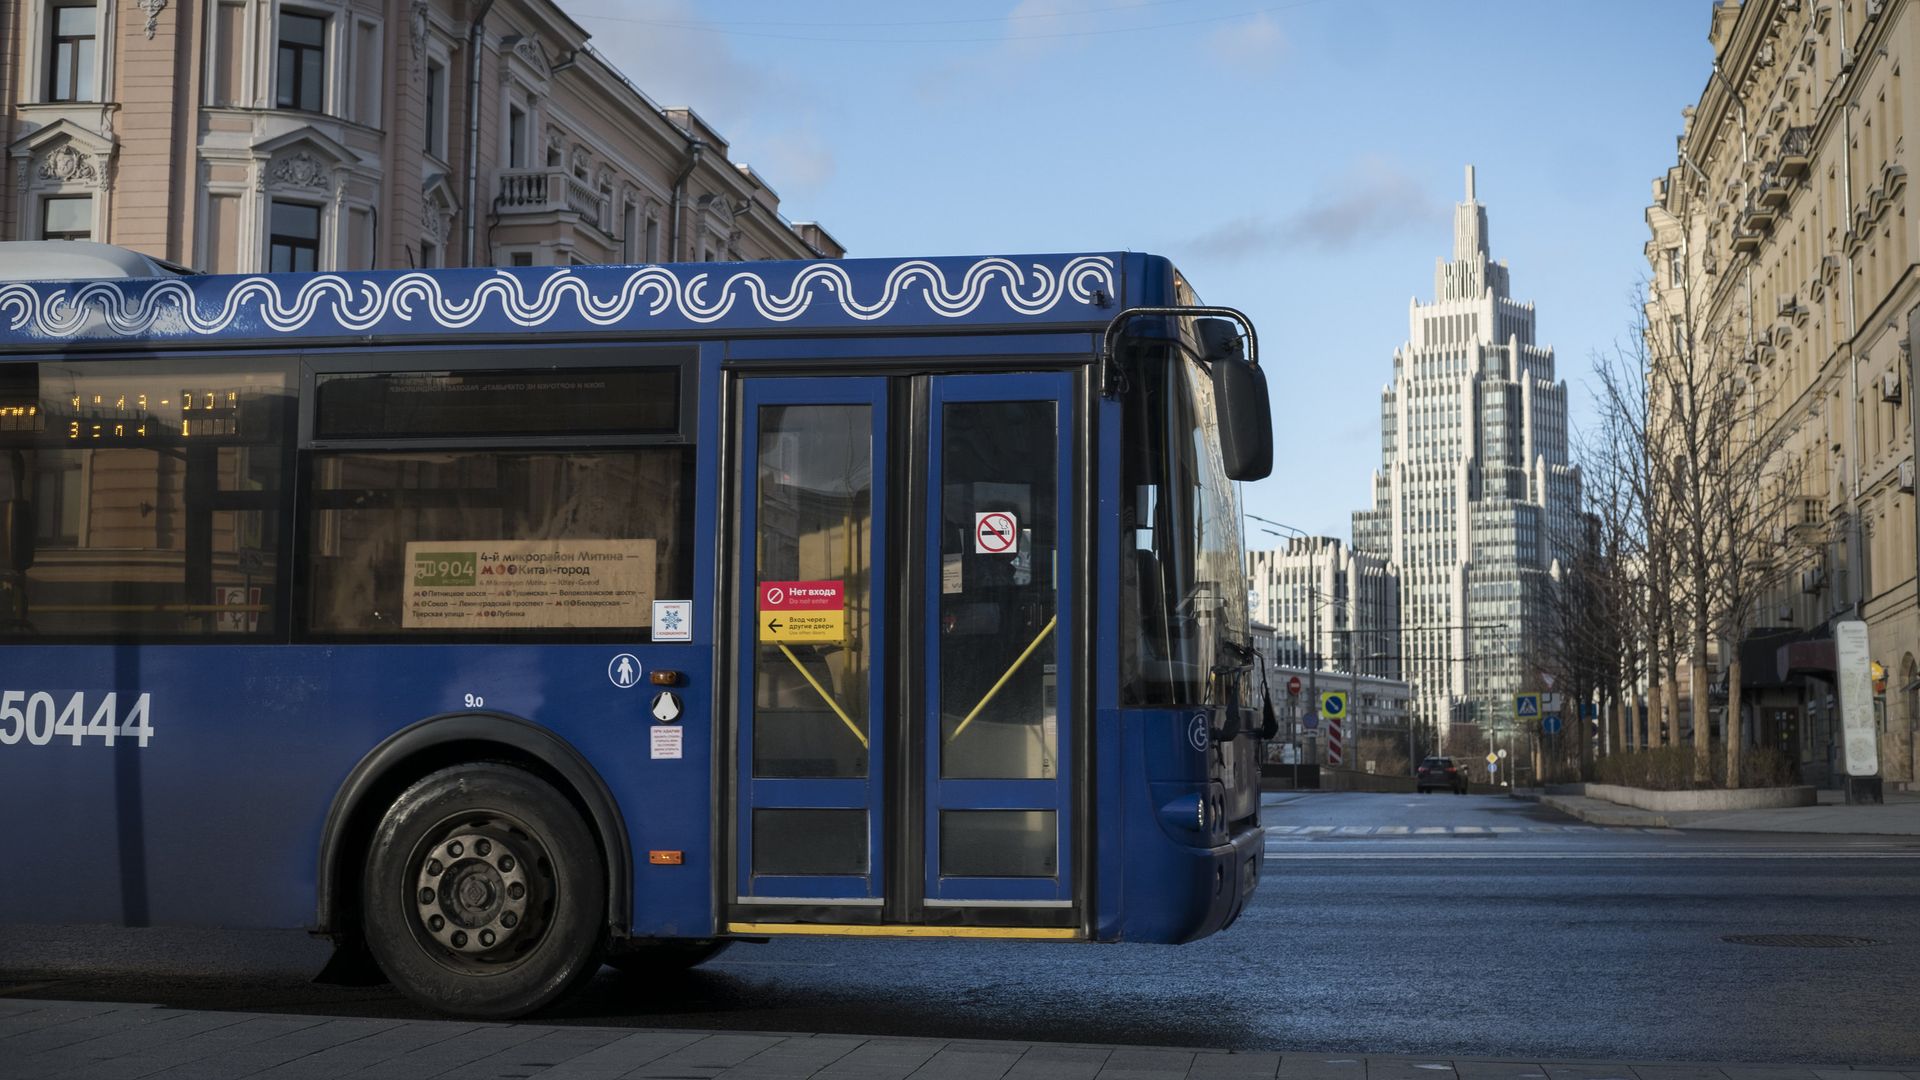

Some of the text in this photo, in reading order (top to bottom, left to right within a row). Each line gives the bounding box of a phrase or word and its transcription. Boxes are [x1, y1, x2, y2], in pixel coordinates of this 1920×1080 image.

[502, 551, 574, 563] микрорайон
[578, 551, 623, 561] Митина
[438, 561, 474, 577] 904
[789, 588, 836, 597] Нет входа
[0, 690, 154, 747] 50444
